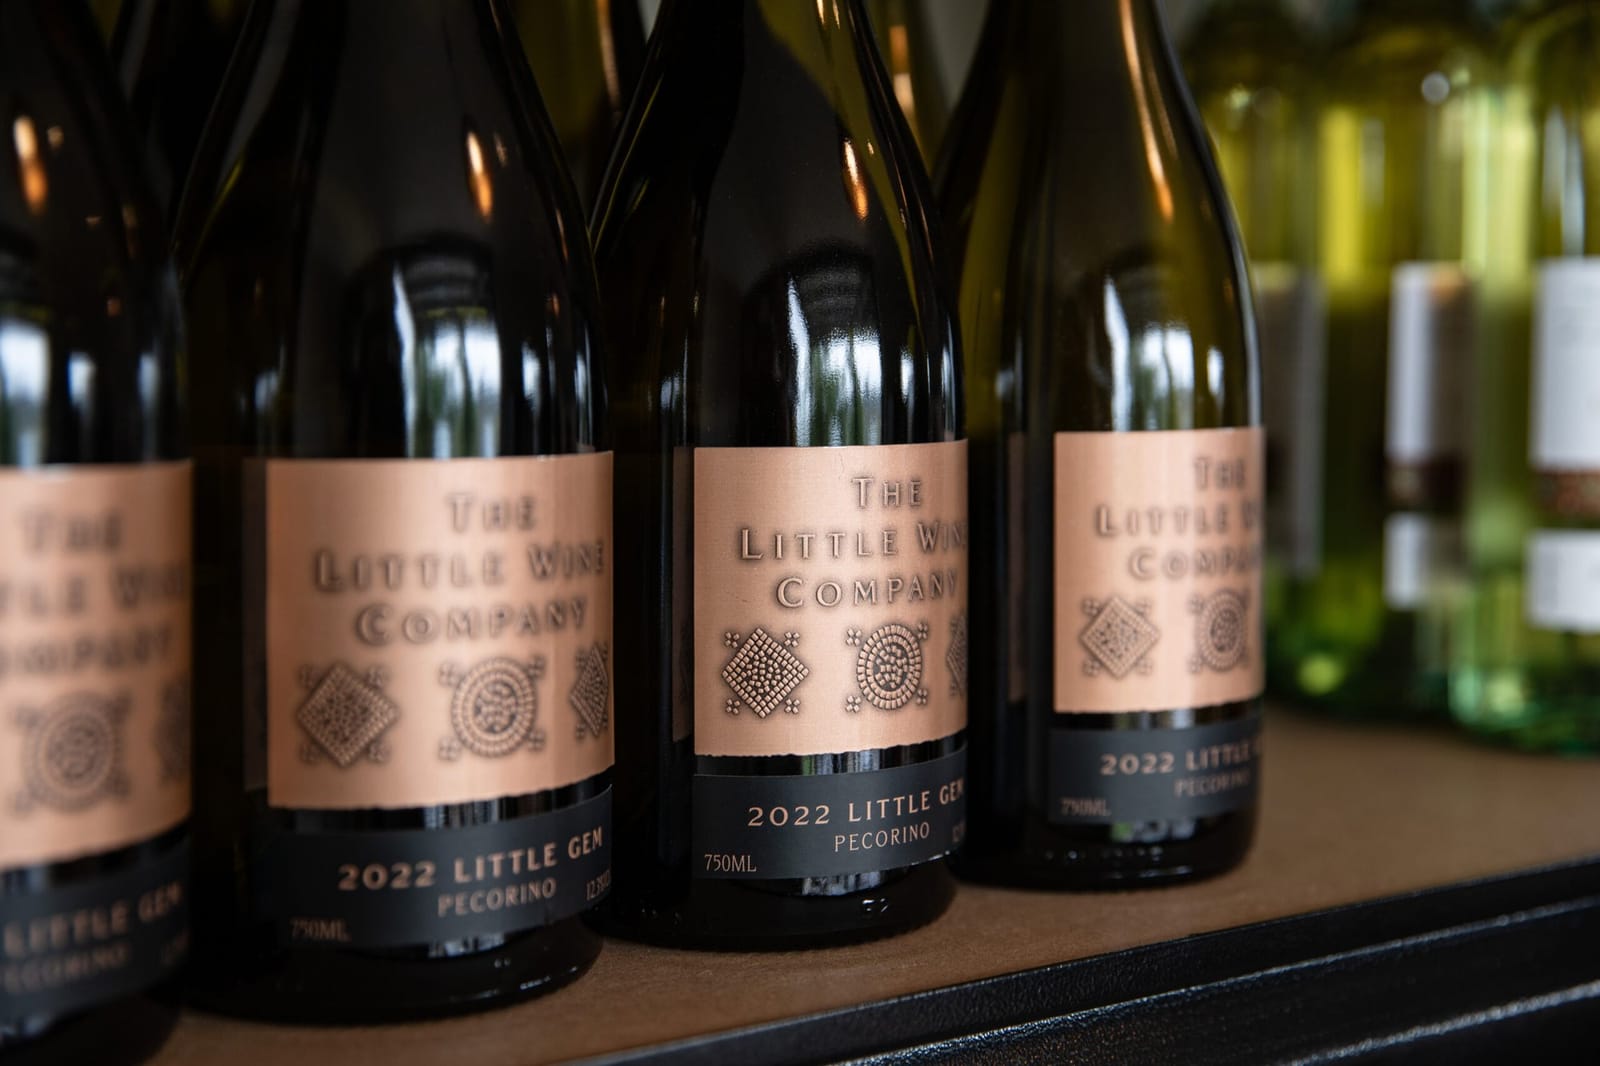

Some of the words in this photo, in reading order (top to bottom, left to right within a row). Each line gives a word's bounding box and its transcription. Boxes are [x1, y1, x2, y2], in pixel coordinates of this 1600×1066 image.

[851, 476, 923, 508] THE
[446, 494, 536, 533] THE
[1095, 502, 1230, 538] LITTLE
[738, 526, 898, 562] LITTLE
[915, 521, 966, 554] WIN
[315, 548, 504, 592] LITTLE
[527, 541, 604, 581] WINE
[774, 571, 957, 608] COMPANY
[354, 596, 587, 646] COMPANY
[1100, 753, 1176, 775] 2022
[747, 805, 831, 827] 2022
[847, 790, 930, 822] LITTLE
[833, 821, 930, 852] PECORINO
[337, 862, 436, 891] 2022
[453, 842, 558, 883] LITTLE
[567, 826, 603, 859] GEM
[704, 854, 757, 873] 750ML
[437, 877, 557, 918] PECORINO
